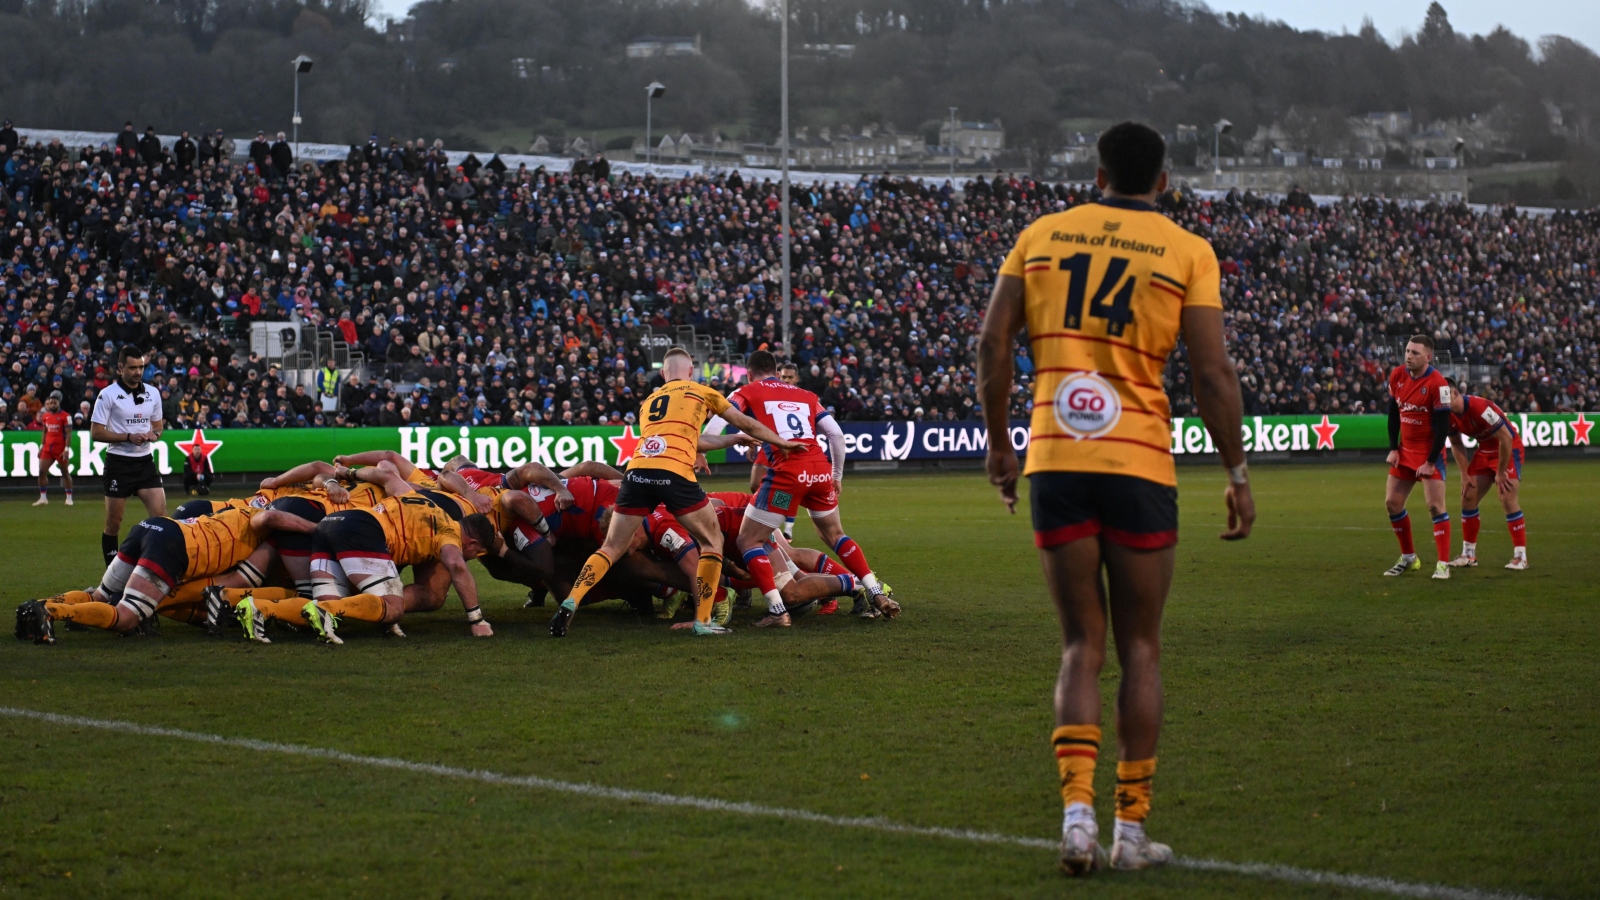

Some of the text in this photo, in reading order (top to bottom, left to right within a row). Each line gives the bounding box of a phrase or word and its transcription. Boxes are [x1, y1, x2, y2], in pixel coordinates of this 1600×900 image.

[1051, 231, 1166, 257] Bank of Ireland
[1059, 252, 1137, 337] 14
[648, 395, 671, 422] 9
[1068, 411, 1104, 421] POWER
[786, 413, 805, 438] 9
[398, 426, 607, 469] Heineken
[632, 474, 672, 485] Tobermore
[797, 470, 831, 487] dyson
